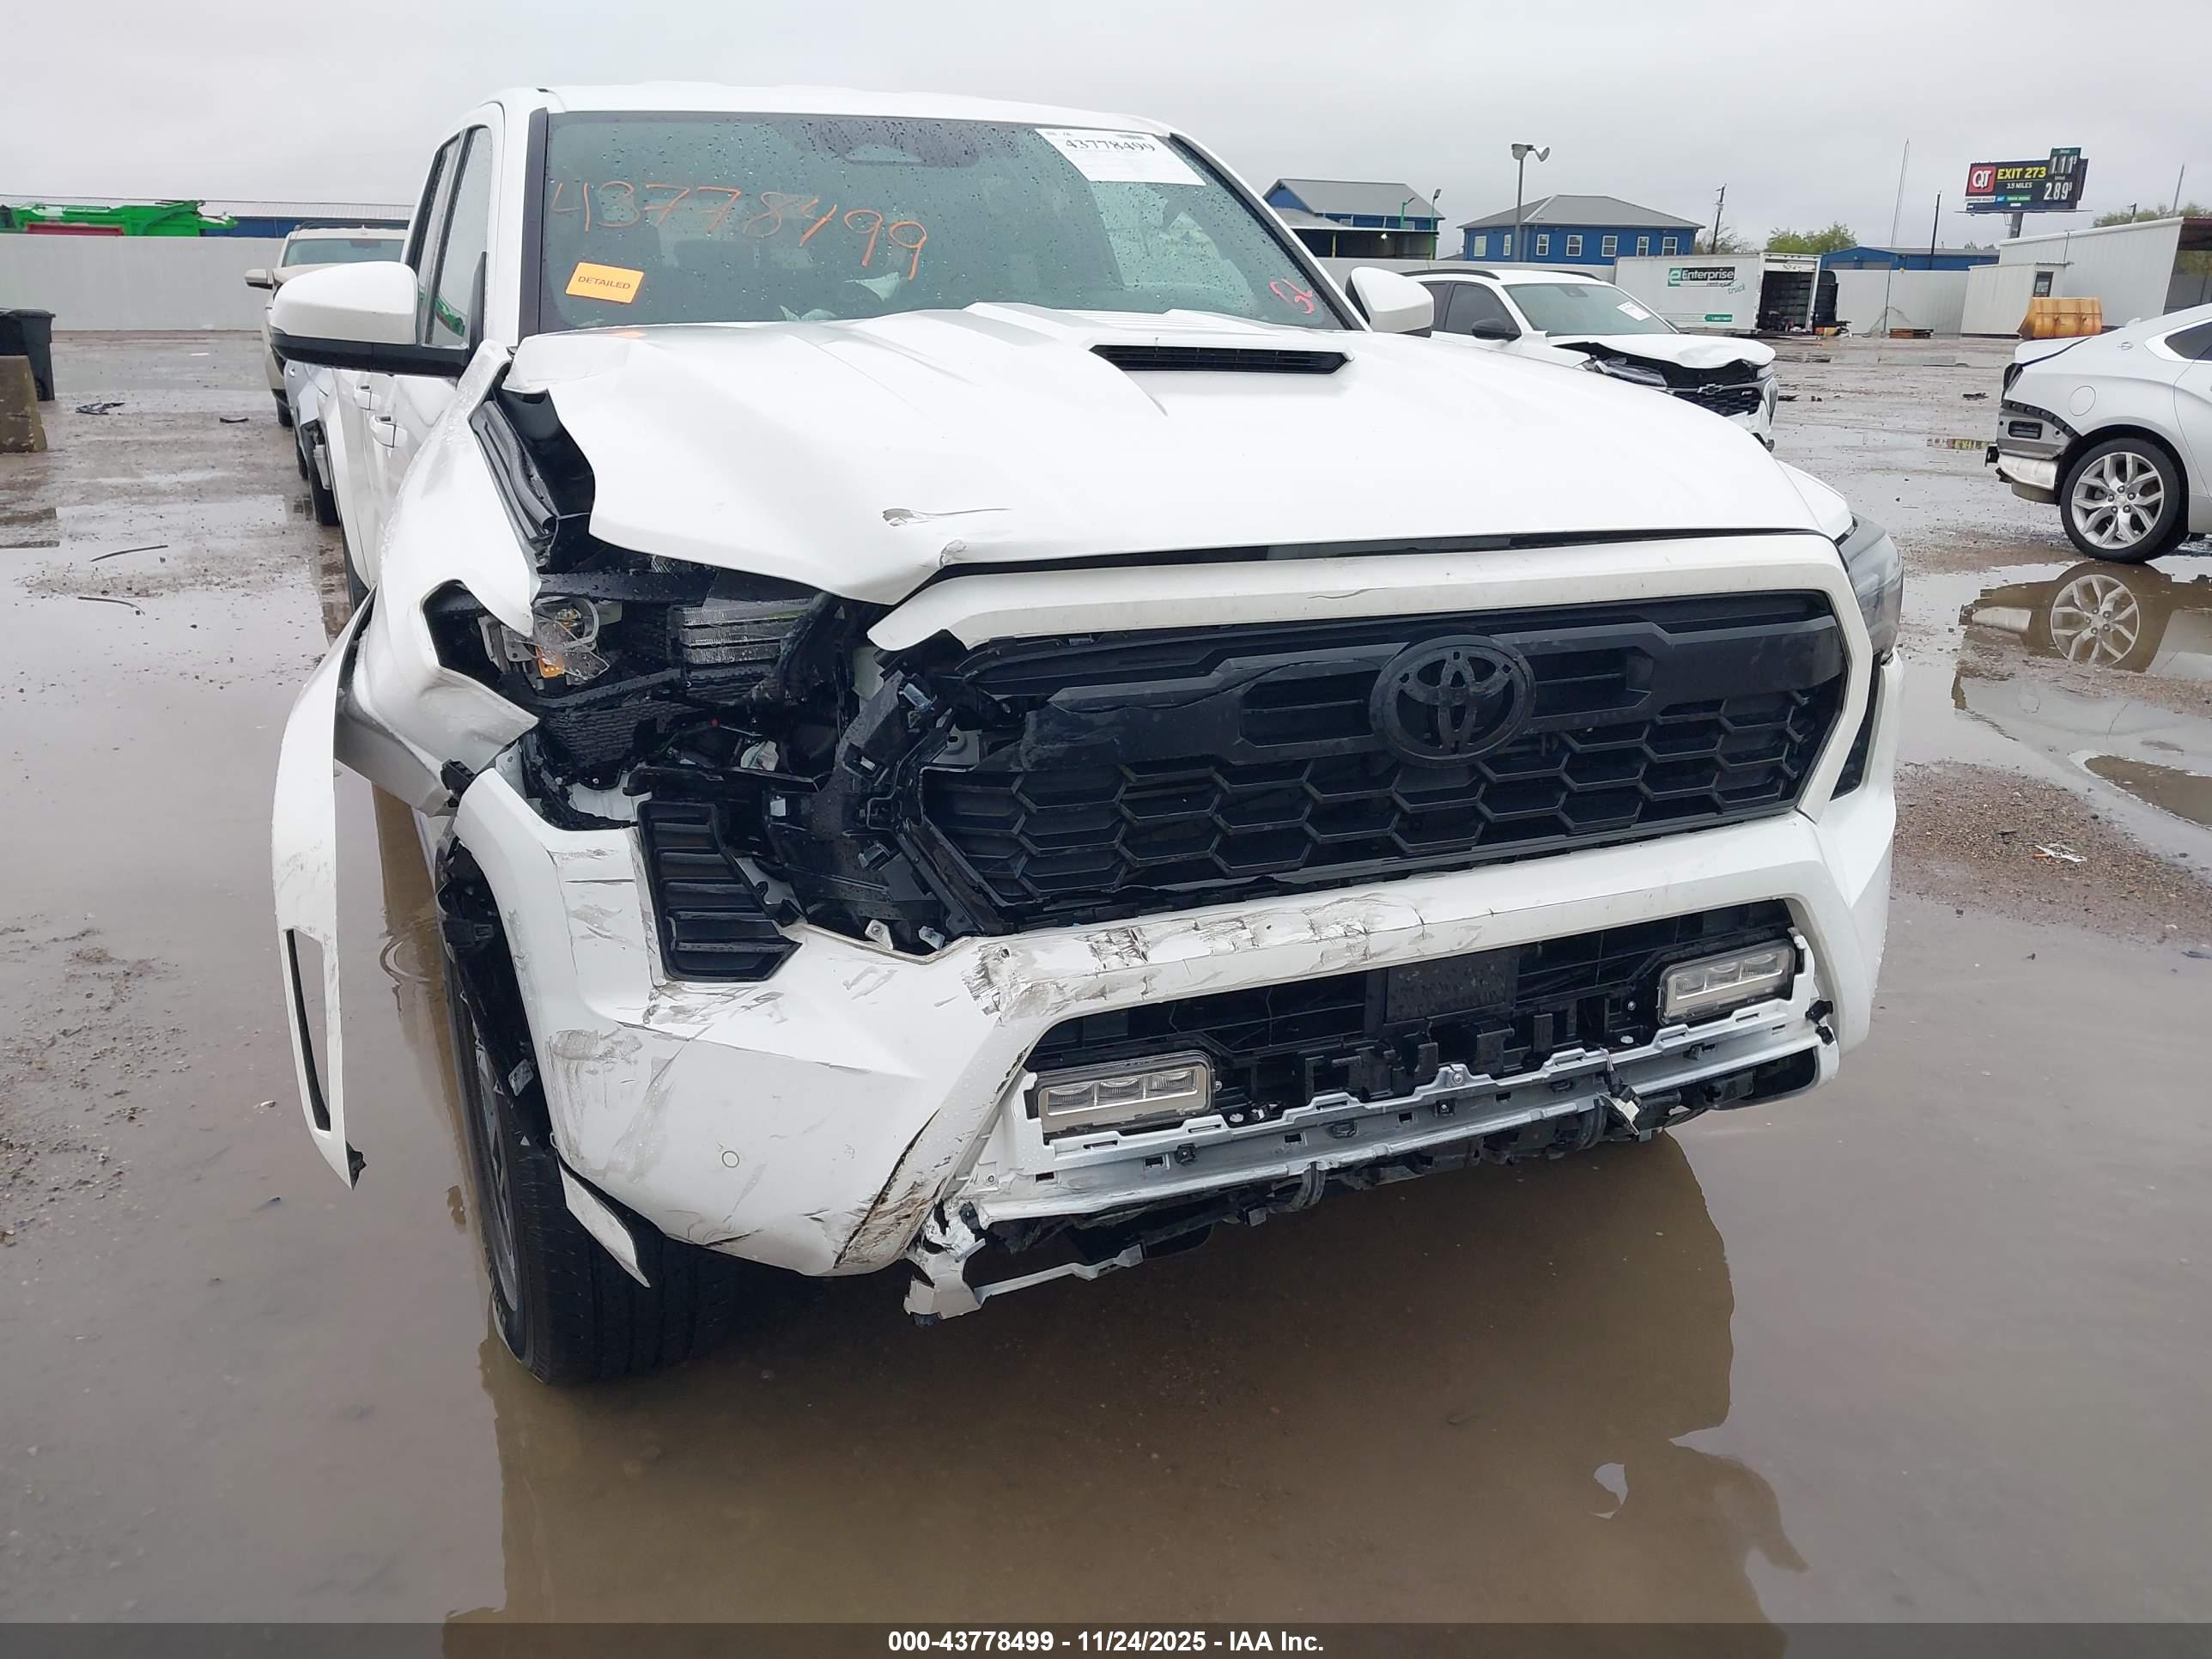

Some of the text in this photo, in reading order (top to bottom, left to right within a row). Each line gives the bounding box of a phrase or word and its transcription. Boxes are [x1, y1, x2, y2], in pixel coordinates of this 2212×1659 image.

[1066, 139, 1156, 151] 43778499
[1972, 170, 1992, 188] QT
[1997, 167, 2023, 179] EXIT
[2024, 166, 2047, 179] 273
[550, 180, 927, 282] 43778499
[1681, 268, 1735, 281] Enterprise
[577, 275, 631, 289] DETAILED
